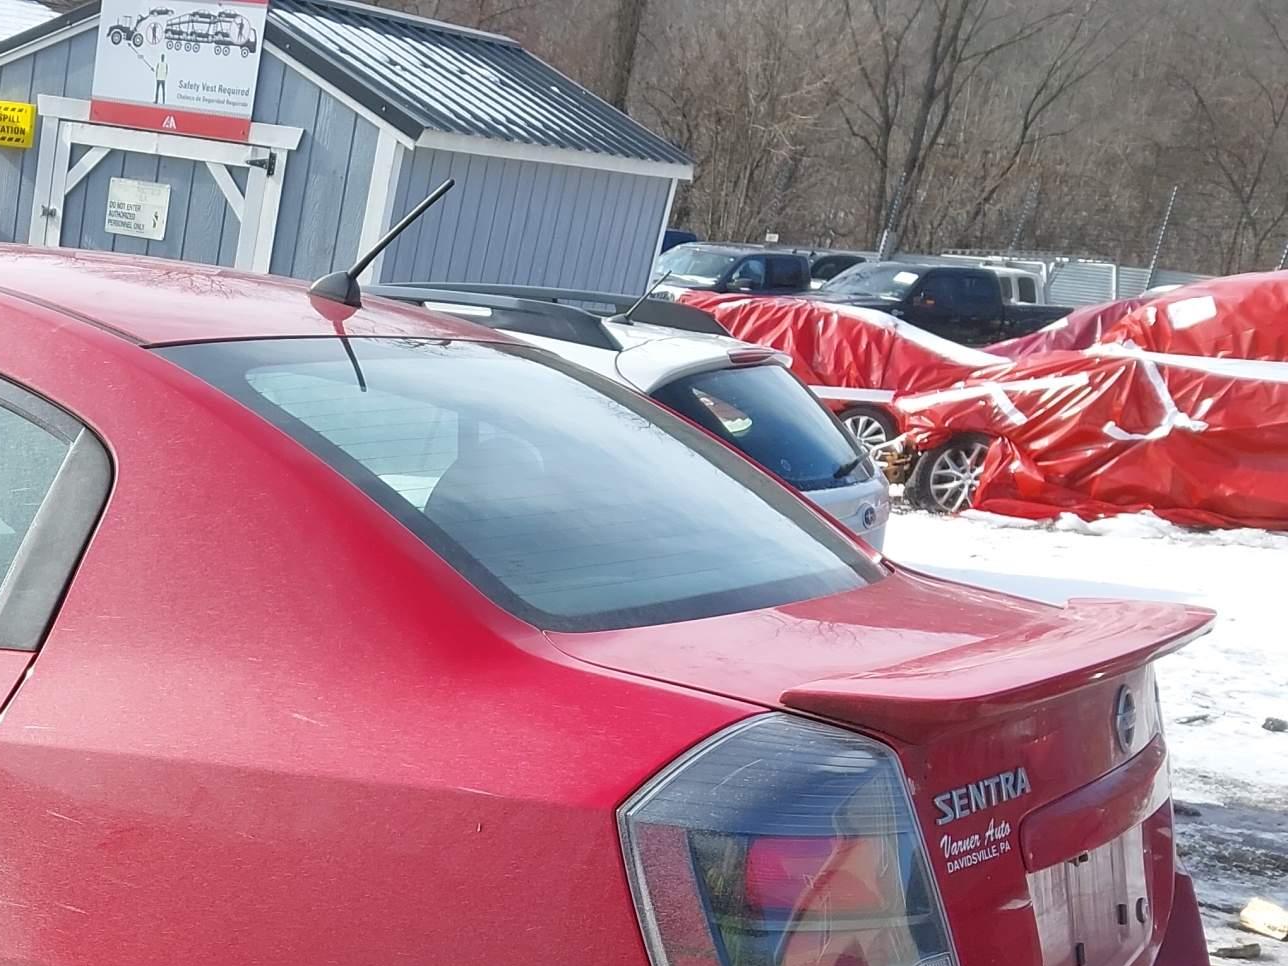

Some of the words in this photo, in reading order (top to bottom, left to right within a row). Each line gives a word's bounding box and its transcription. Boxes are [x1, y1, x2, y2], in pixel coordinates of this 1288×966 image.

[178, 79, 200, 92] Safety
[202, 82, 216, 93] Vest
[218, 84, 250, 97] Required
[109, 200, 116, 209] DO
[117, 202, 126, 210] NOT
[127, 204, 141, 212] ENTER
[107, 219, 132, 229] PERSONNEL
[133, 223, 144, 231] ONLY
[934, 767, 1031, 825] SENTRA
[940, 834, 980, 859] Varner
[985, 818, 1011, 845] Auto
[1000, 841, 1011, 854] PA
